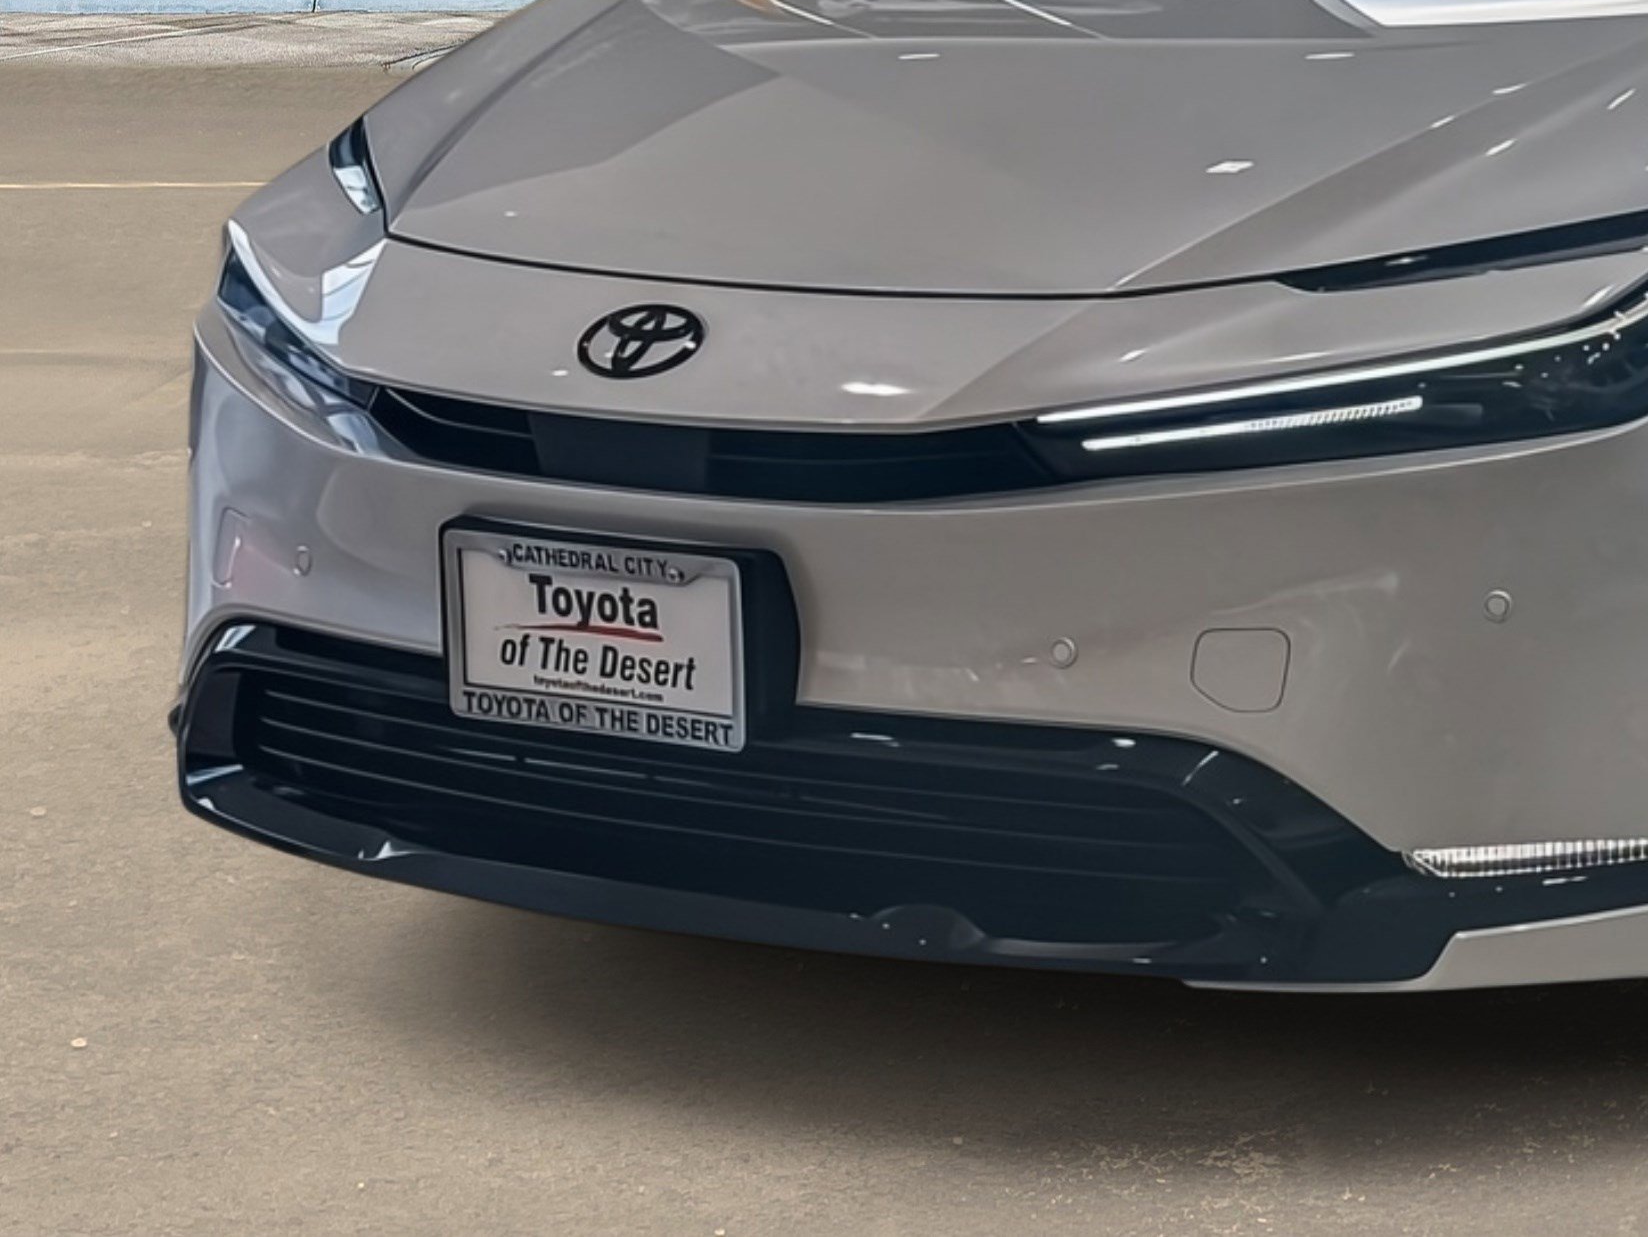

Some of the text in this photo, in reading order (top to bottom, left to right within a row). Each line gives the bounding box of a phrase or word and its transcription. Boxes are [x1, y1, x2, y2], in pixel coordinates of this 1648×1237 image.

[512, 543, 668, 577] CATHEDRAL CITY
[528, 573, 660, 630] Toyota
[501, 633, 696, 690] of The Desert
[462, 690, 733, 746] TOYOTA OF THE DESERT
